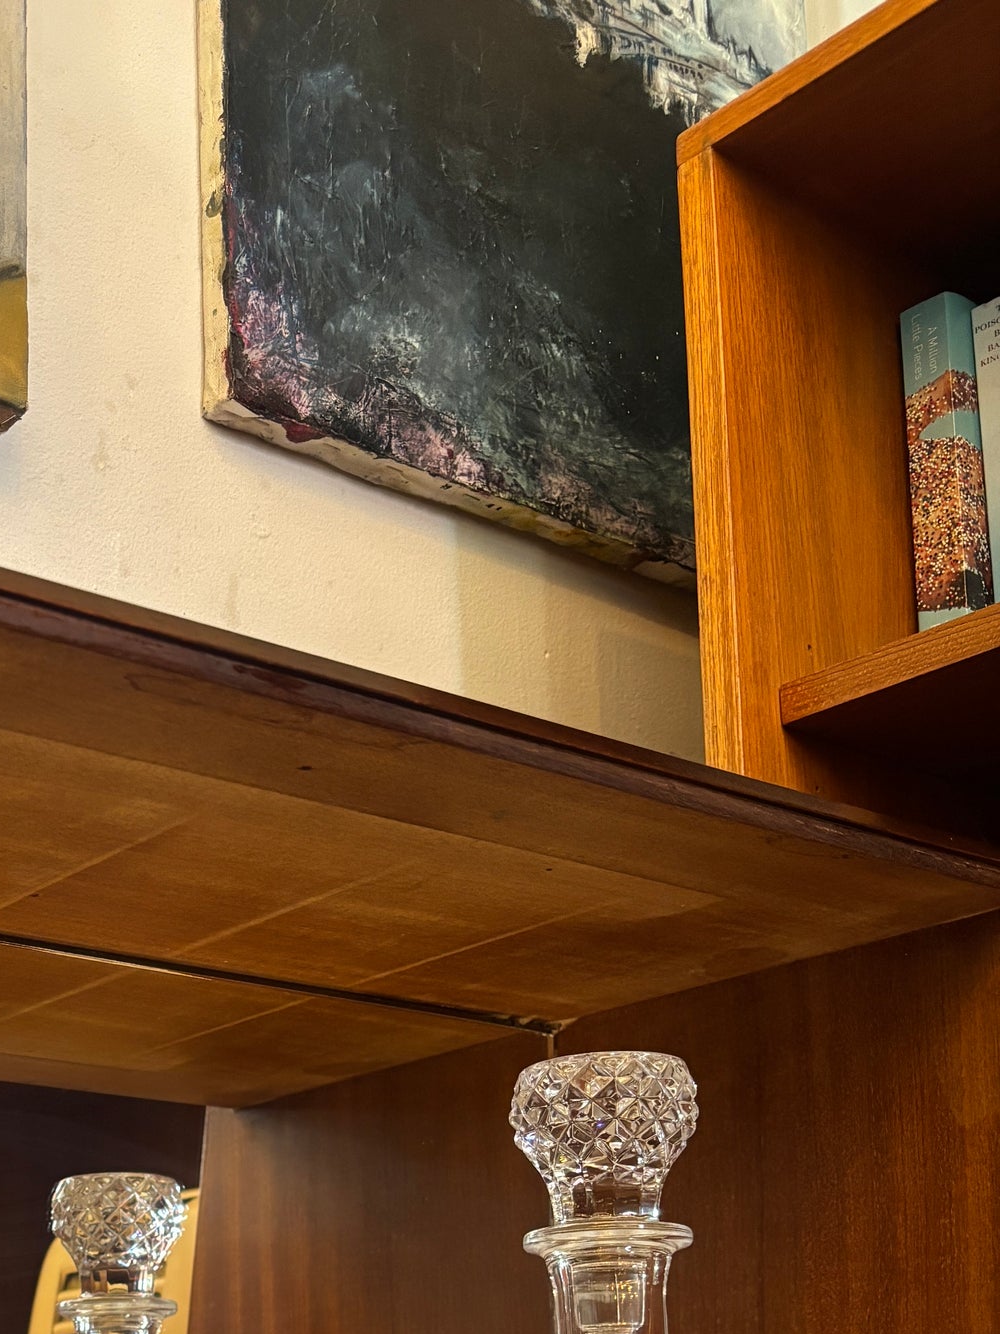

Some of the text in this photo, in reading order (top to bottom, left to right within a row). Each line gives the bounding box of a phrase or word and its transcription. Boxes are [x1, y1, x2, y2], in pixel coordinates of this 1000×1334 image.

[911, 313, 923, 380] Little Pieces
[928, 336, 938, 374] Million
